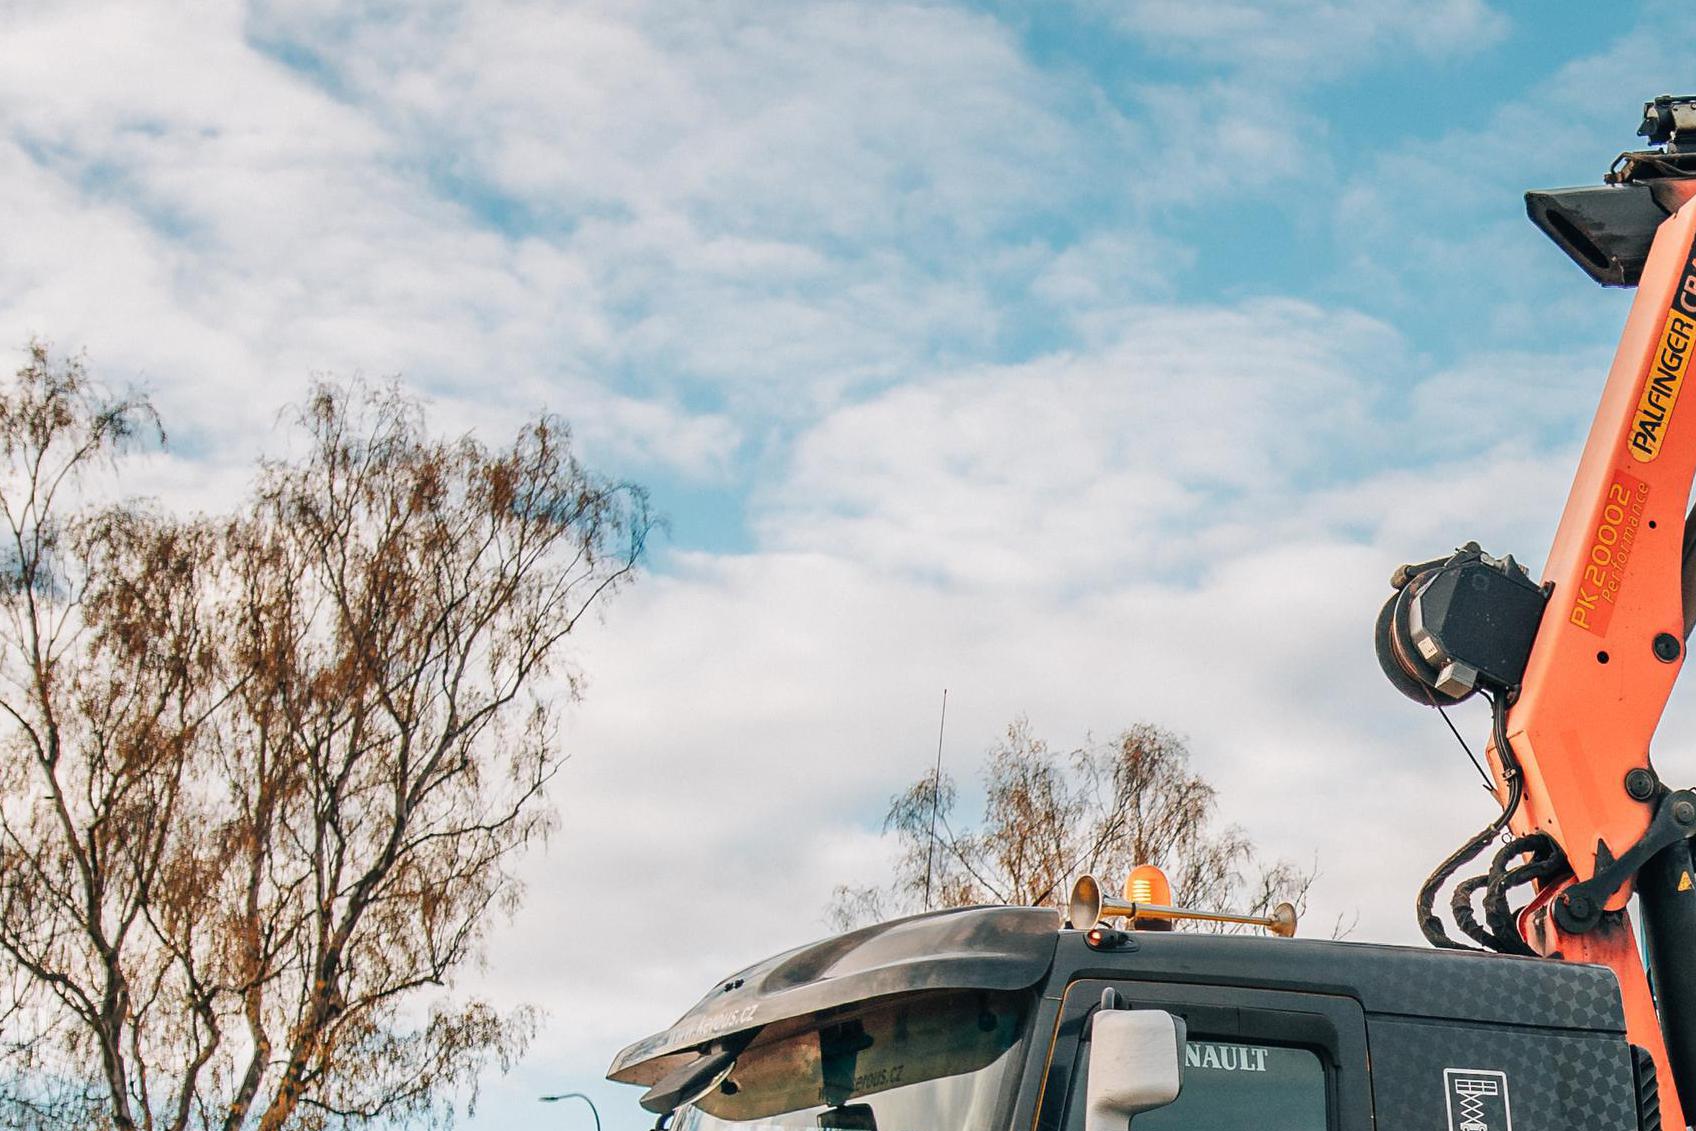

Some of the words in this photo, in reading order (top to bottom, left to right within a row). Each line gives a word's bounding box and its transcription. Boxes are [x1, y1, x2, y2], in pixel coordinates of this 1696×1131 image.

[1632, 316, 1695, 456] PALFINGER
[1584, 482, 1632, 588] 20002
[1601, 481, 1650, 604] Performance
[1570, 586, 1600, 630] PK
[1185, 1043, 1268, 1072] NAULT
